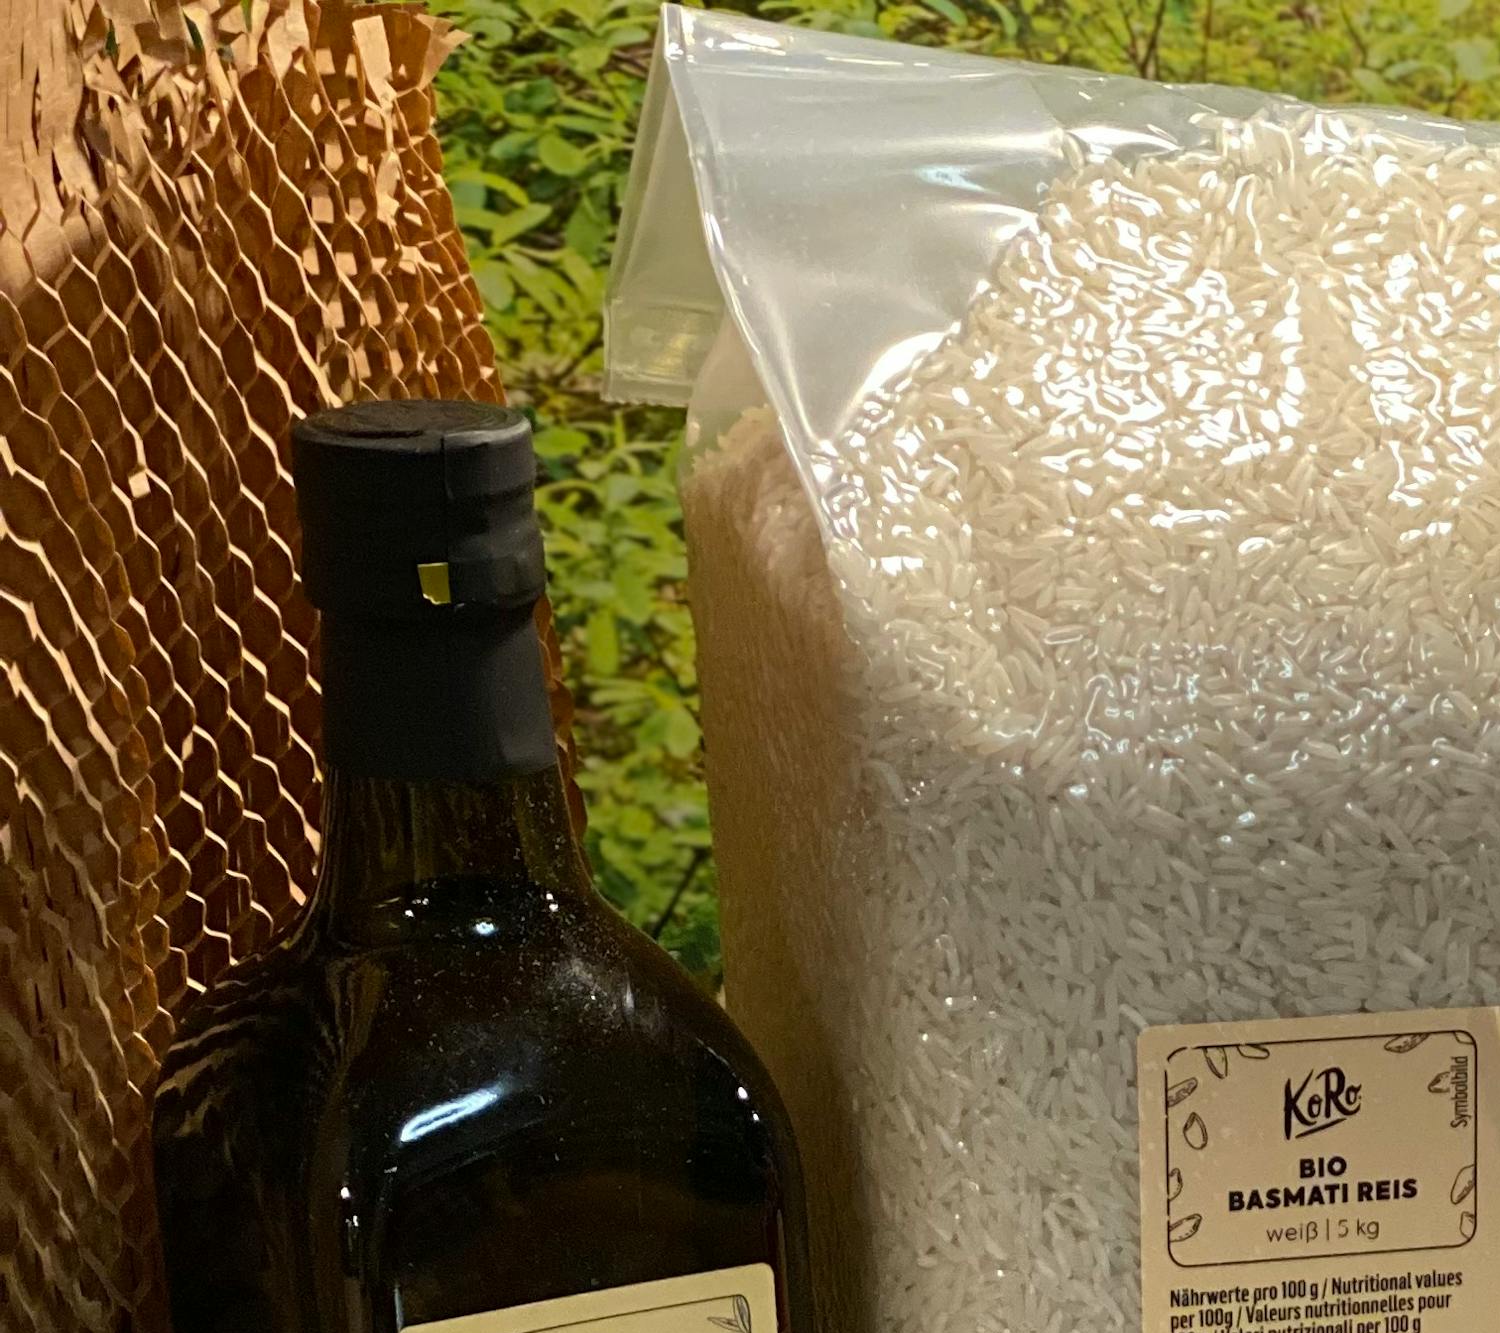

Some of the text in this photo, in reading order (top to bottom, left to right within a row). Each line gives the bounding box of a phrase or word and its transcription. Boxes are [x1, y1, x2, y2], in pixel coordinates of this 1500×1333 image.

[1284, 1067, 1362, 1141] KoRo
[1451, 1056, 1468, 1128] Symbolbild
[1299, 1155, 1347, 1179] BIO
[1228, 1177, 1418, 1212] BASMATI REIS
[1266, 1220, 1318, 1244] weiß
[1337, 1218, 1349, 1238] 5
[1356, 1217, 1380, 1240] kg
[1169, 1285, 1249, 1308] Nährwerte
[1252, 1285, 1278, 1307] pro
[1281, 1279, 1306, 1299] 100
[1309, 1282, 1318, 1301] g
[1331, 1272, 1412, 1295] Nutritional
[1414, 1270, 1462, 1289] values
